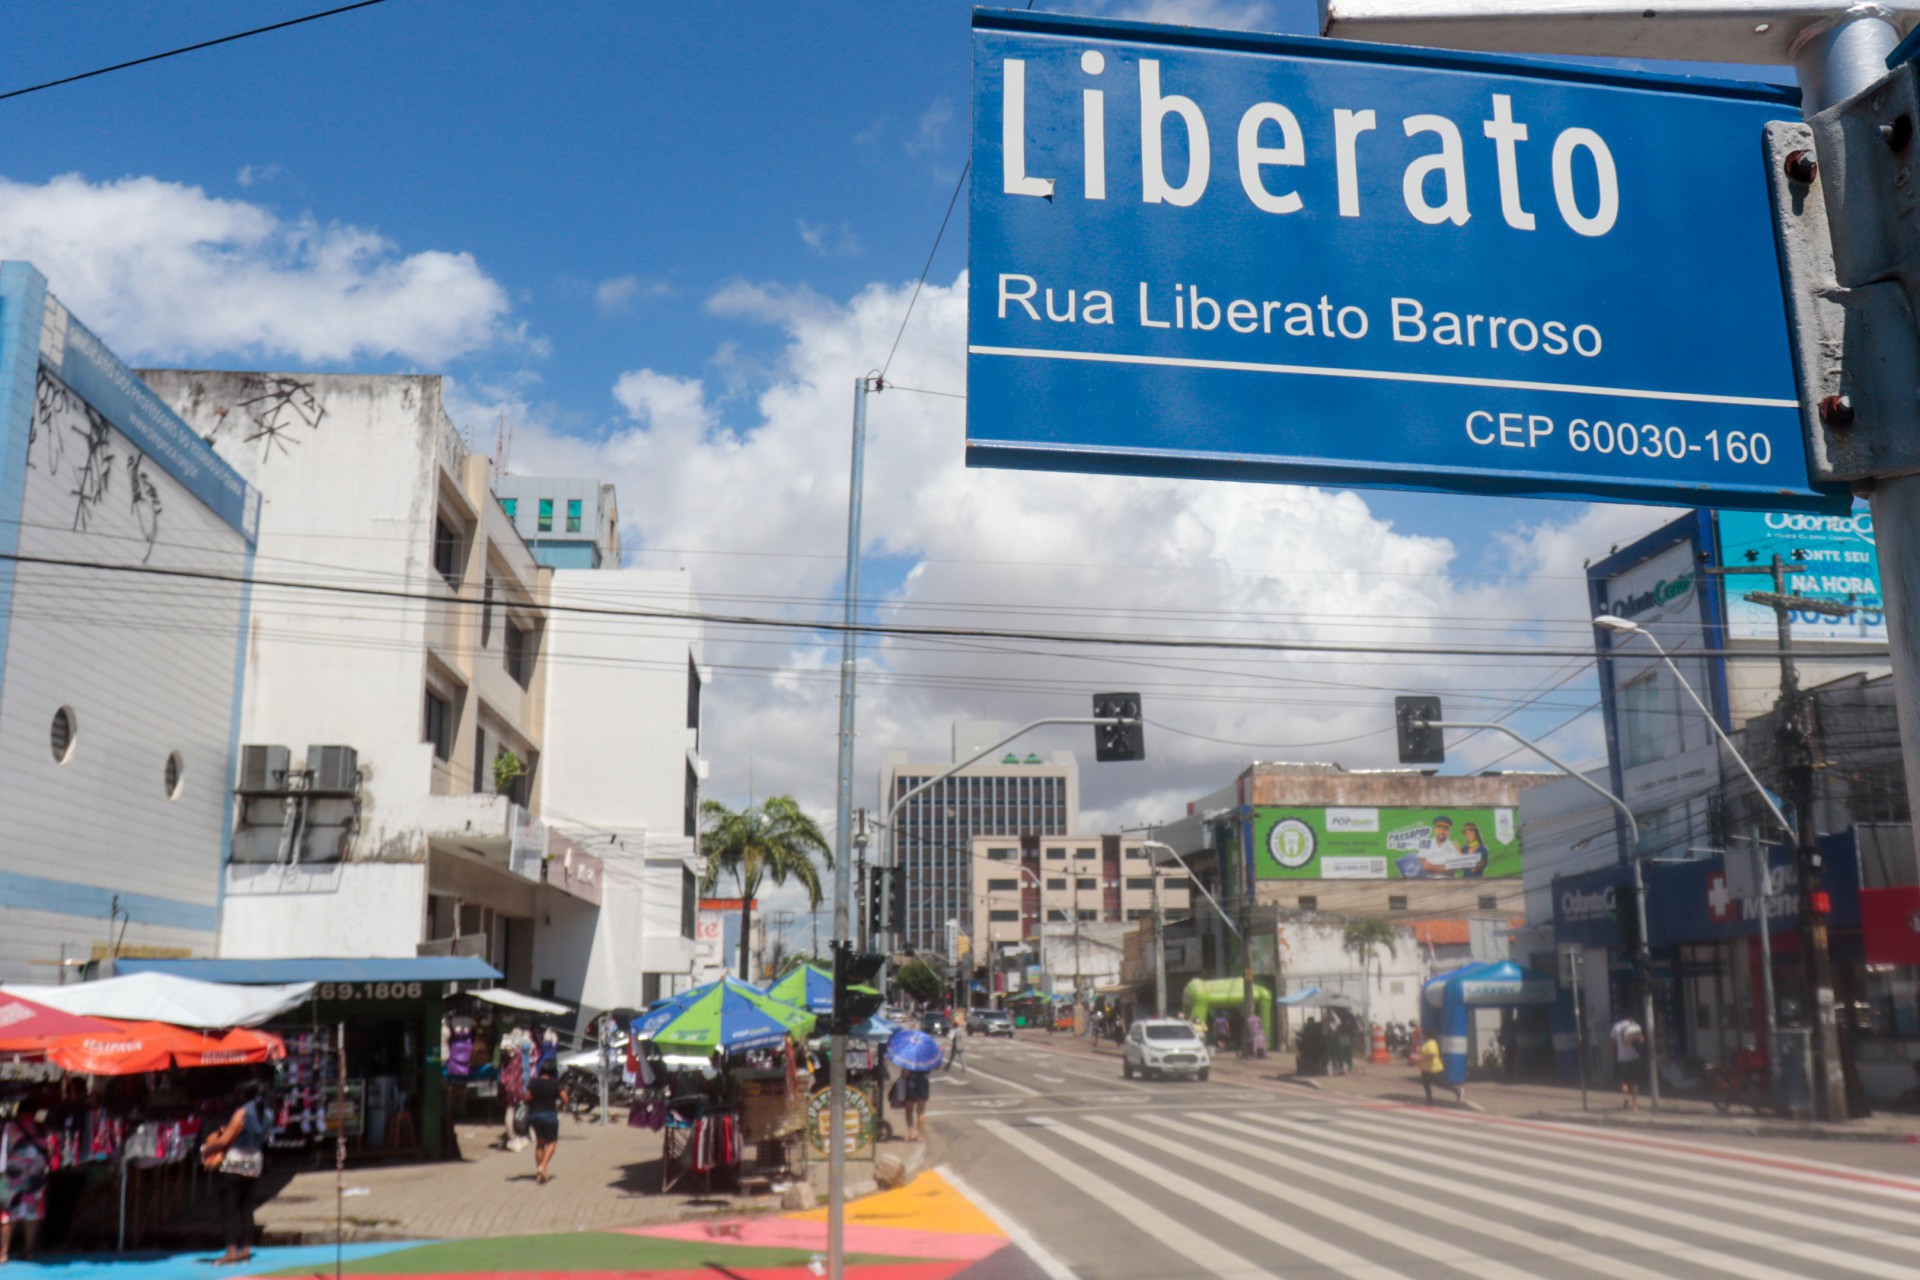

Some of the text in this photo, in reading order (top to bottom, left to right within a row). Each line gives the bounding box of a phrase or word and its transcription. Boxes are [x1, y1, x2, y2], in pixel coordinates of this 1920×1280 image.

[1003, 50, 1620, 237] Liberato
[998, 273, 1603, 358] Rua Liberato Barroso
[1465, 410, 1773, 466] CEP 60030-160
[1792, 549, 1869, 563] ONTE SEU
[1792, 576, 1876, 594] NA HORA
